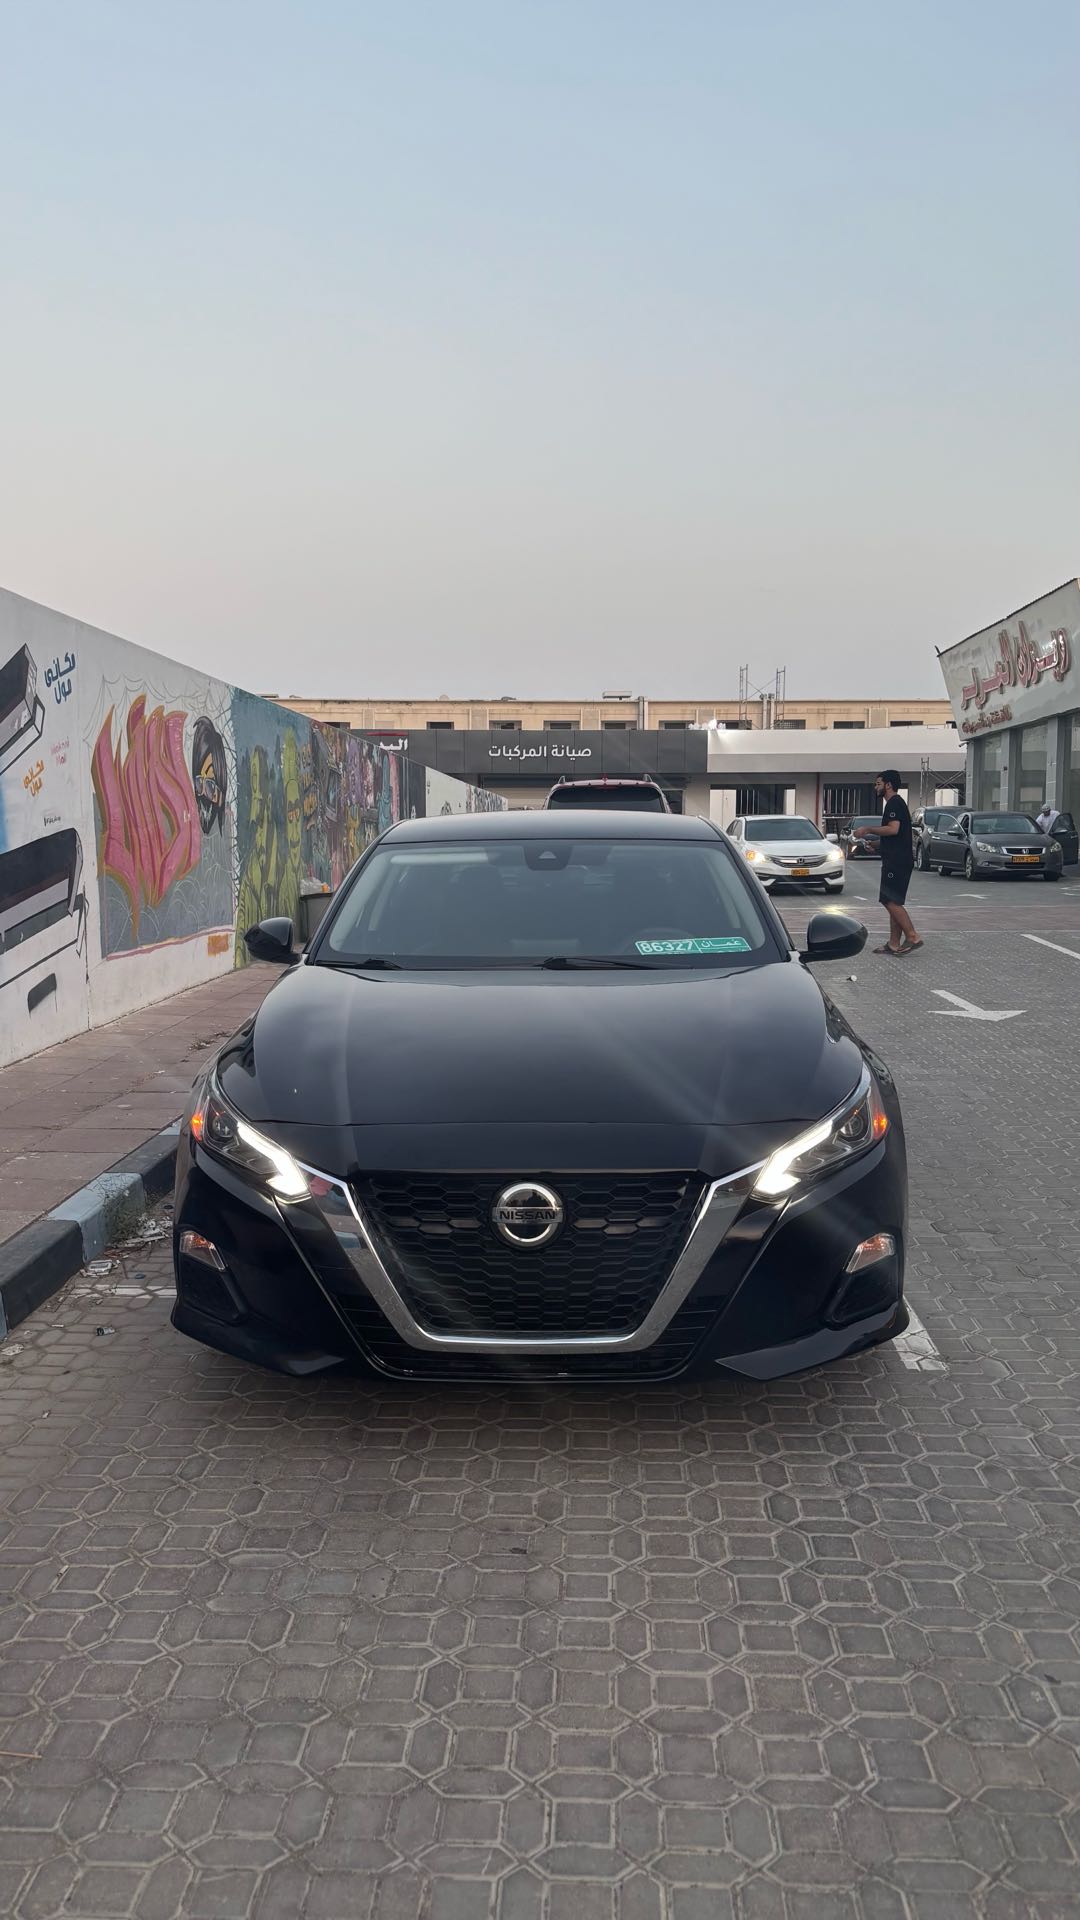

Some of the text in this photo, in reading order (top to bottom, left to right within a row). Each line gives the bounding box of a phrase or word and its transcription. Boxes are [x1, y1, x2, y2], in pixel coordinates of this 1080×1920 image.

[488, 744, 592, 760] صيانة المركبات
[640, 941, 693, 953] 86327
[500, 1211, 556, 1220] NISSAN
